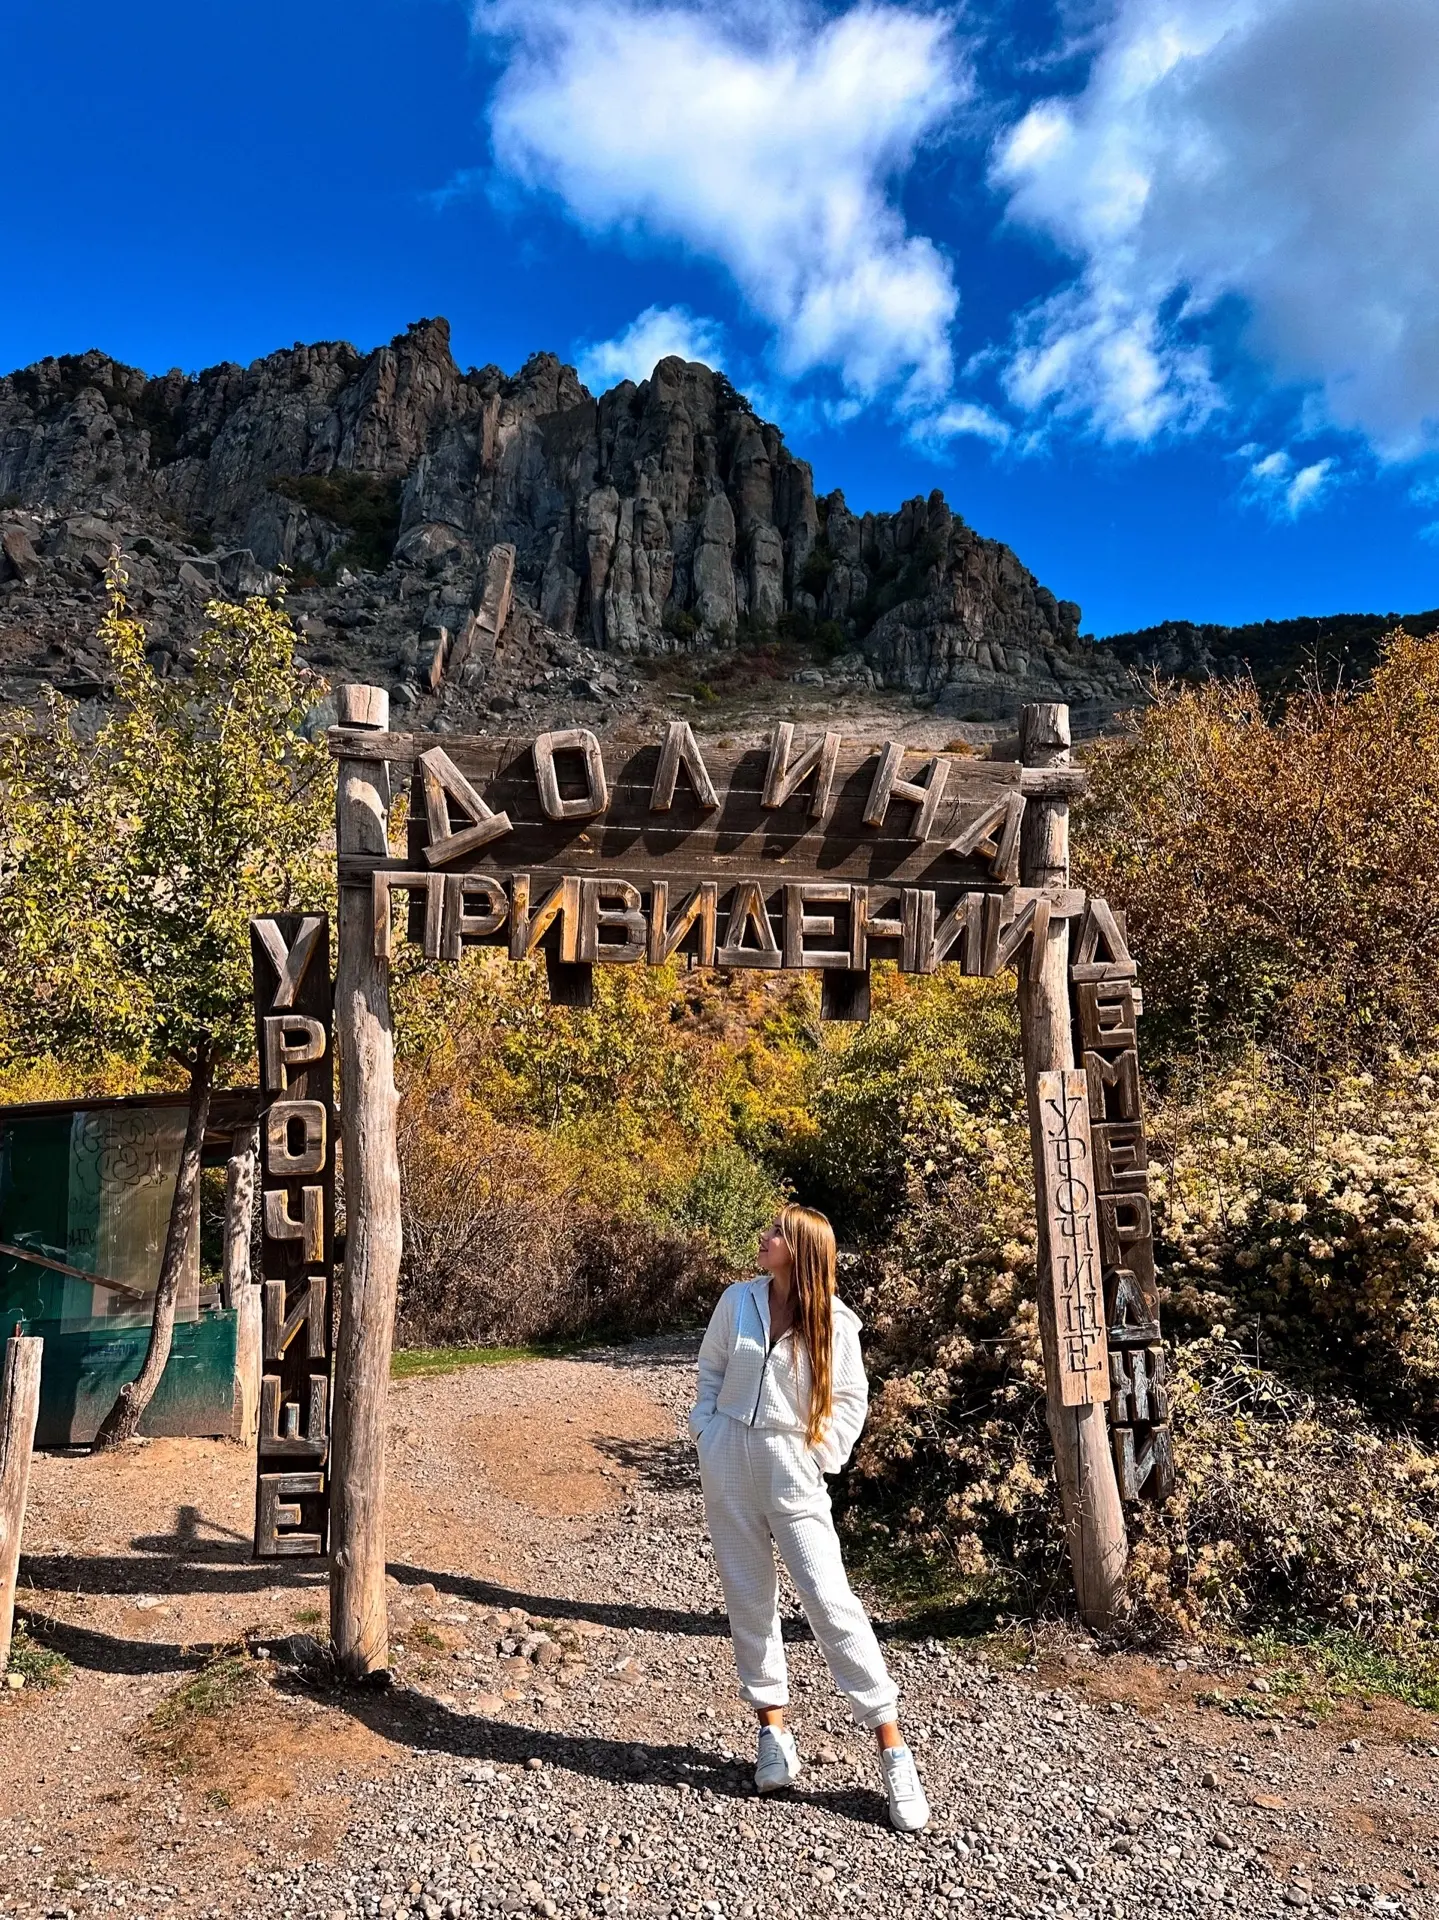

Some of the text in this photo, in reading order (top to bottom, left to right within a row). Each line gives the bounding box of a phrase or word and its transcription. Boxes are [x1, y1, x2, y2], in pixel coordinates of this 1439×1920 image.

[416, 720, 1027, 882] ДОЛИНА
[250, 916, 329, 1555] УРОЧИЩЕ
[1045, 1096, 1102, 1373] УРОЧИЩЕ
[1070, 898, 1175, 1501] ДЕМЕРДЖИ
